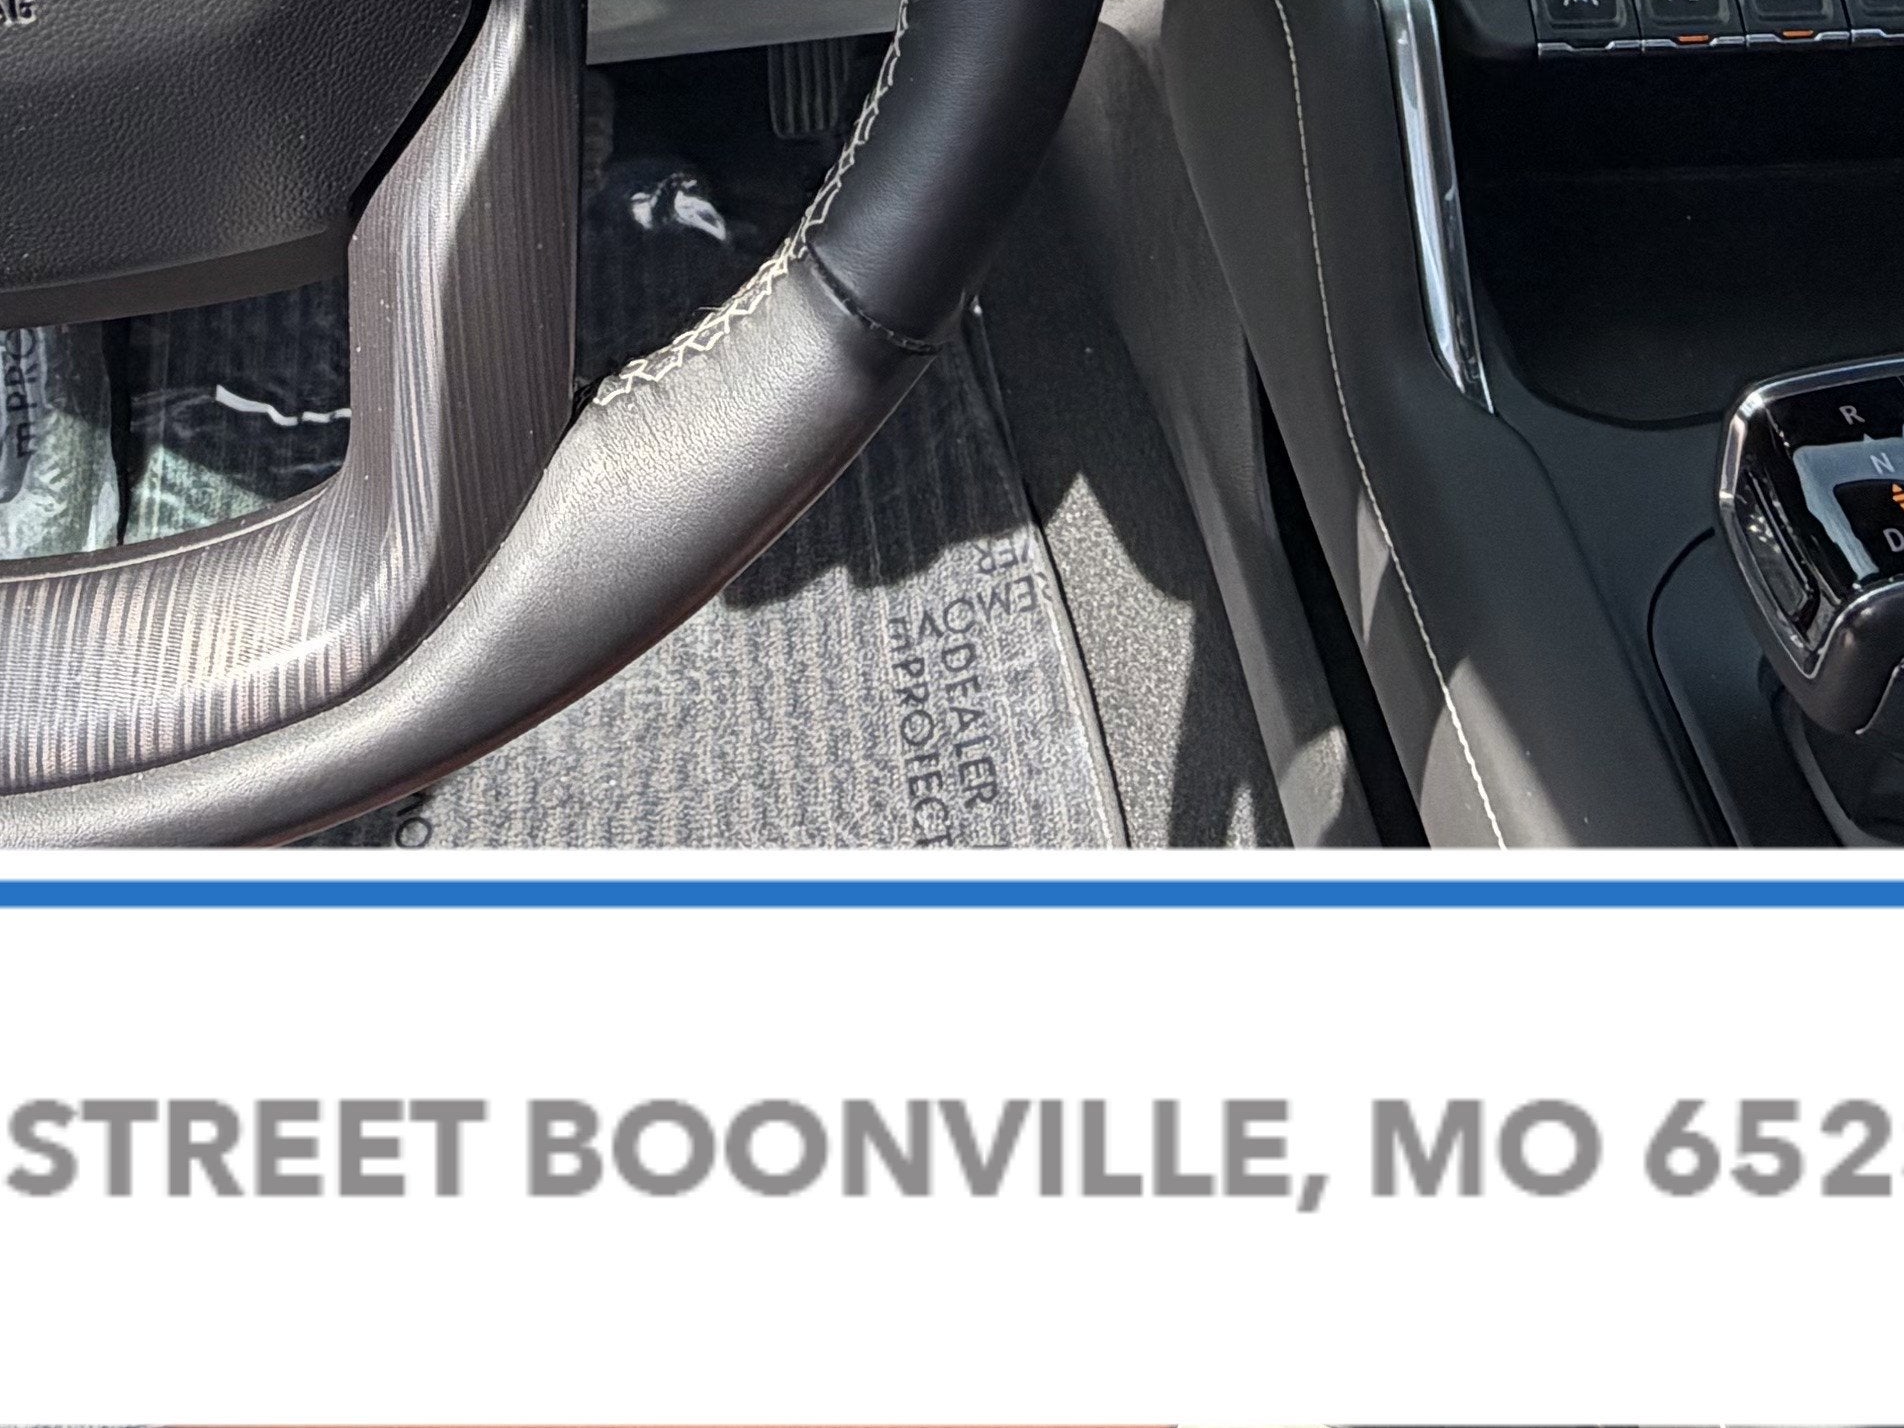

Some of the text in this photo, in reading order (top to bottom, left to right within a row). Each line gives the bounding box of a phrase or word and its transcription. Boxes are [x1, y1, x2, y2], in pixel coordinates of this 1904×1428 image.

[1839, 404, 1865, 426] R
[1870, 451, 1896, 475] N
[942, 643, 998, 809] DEALER
